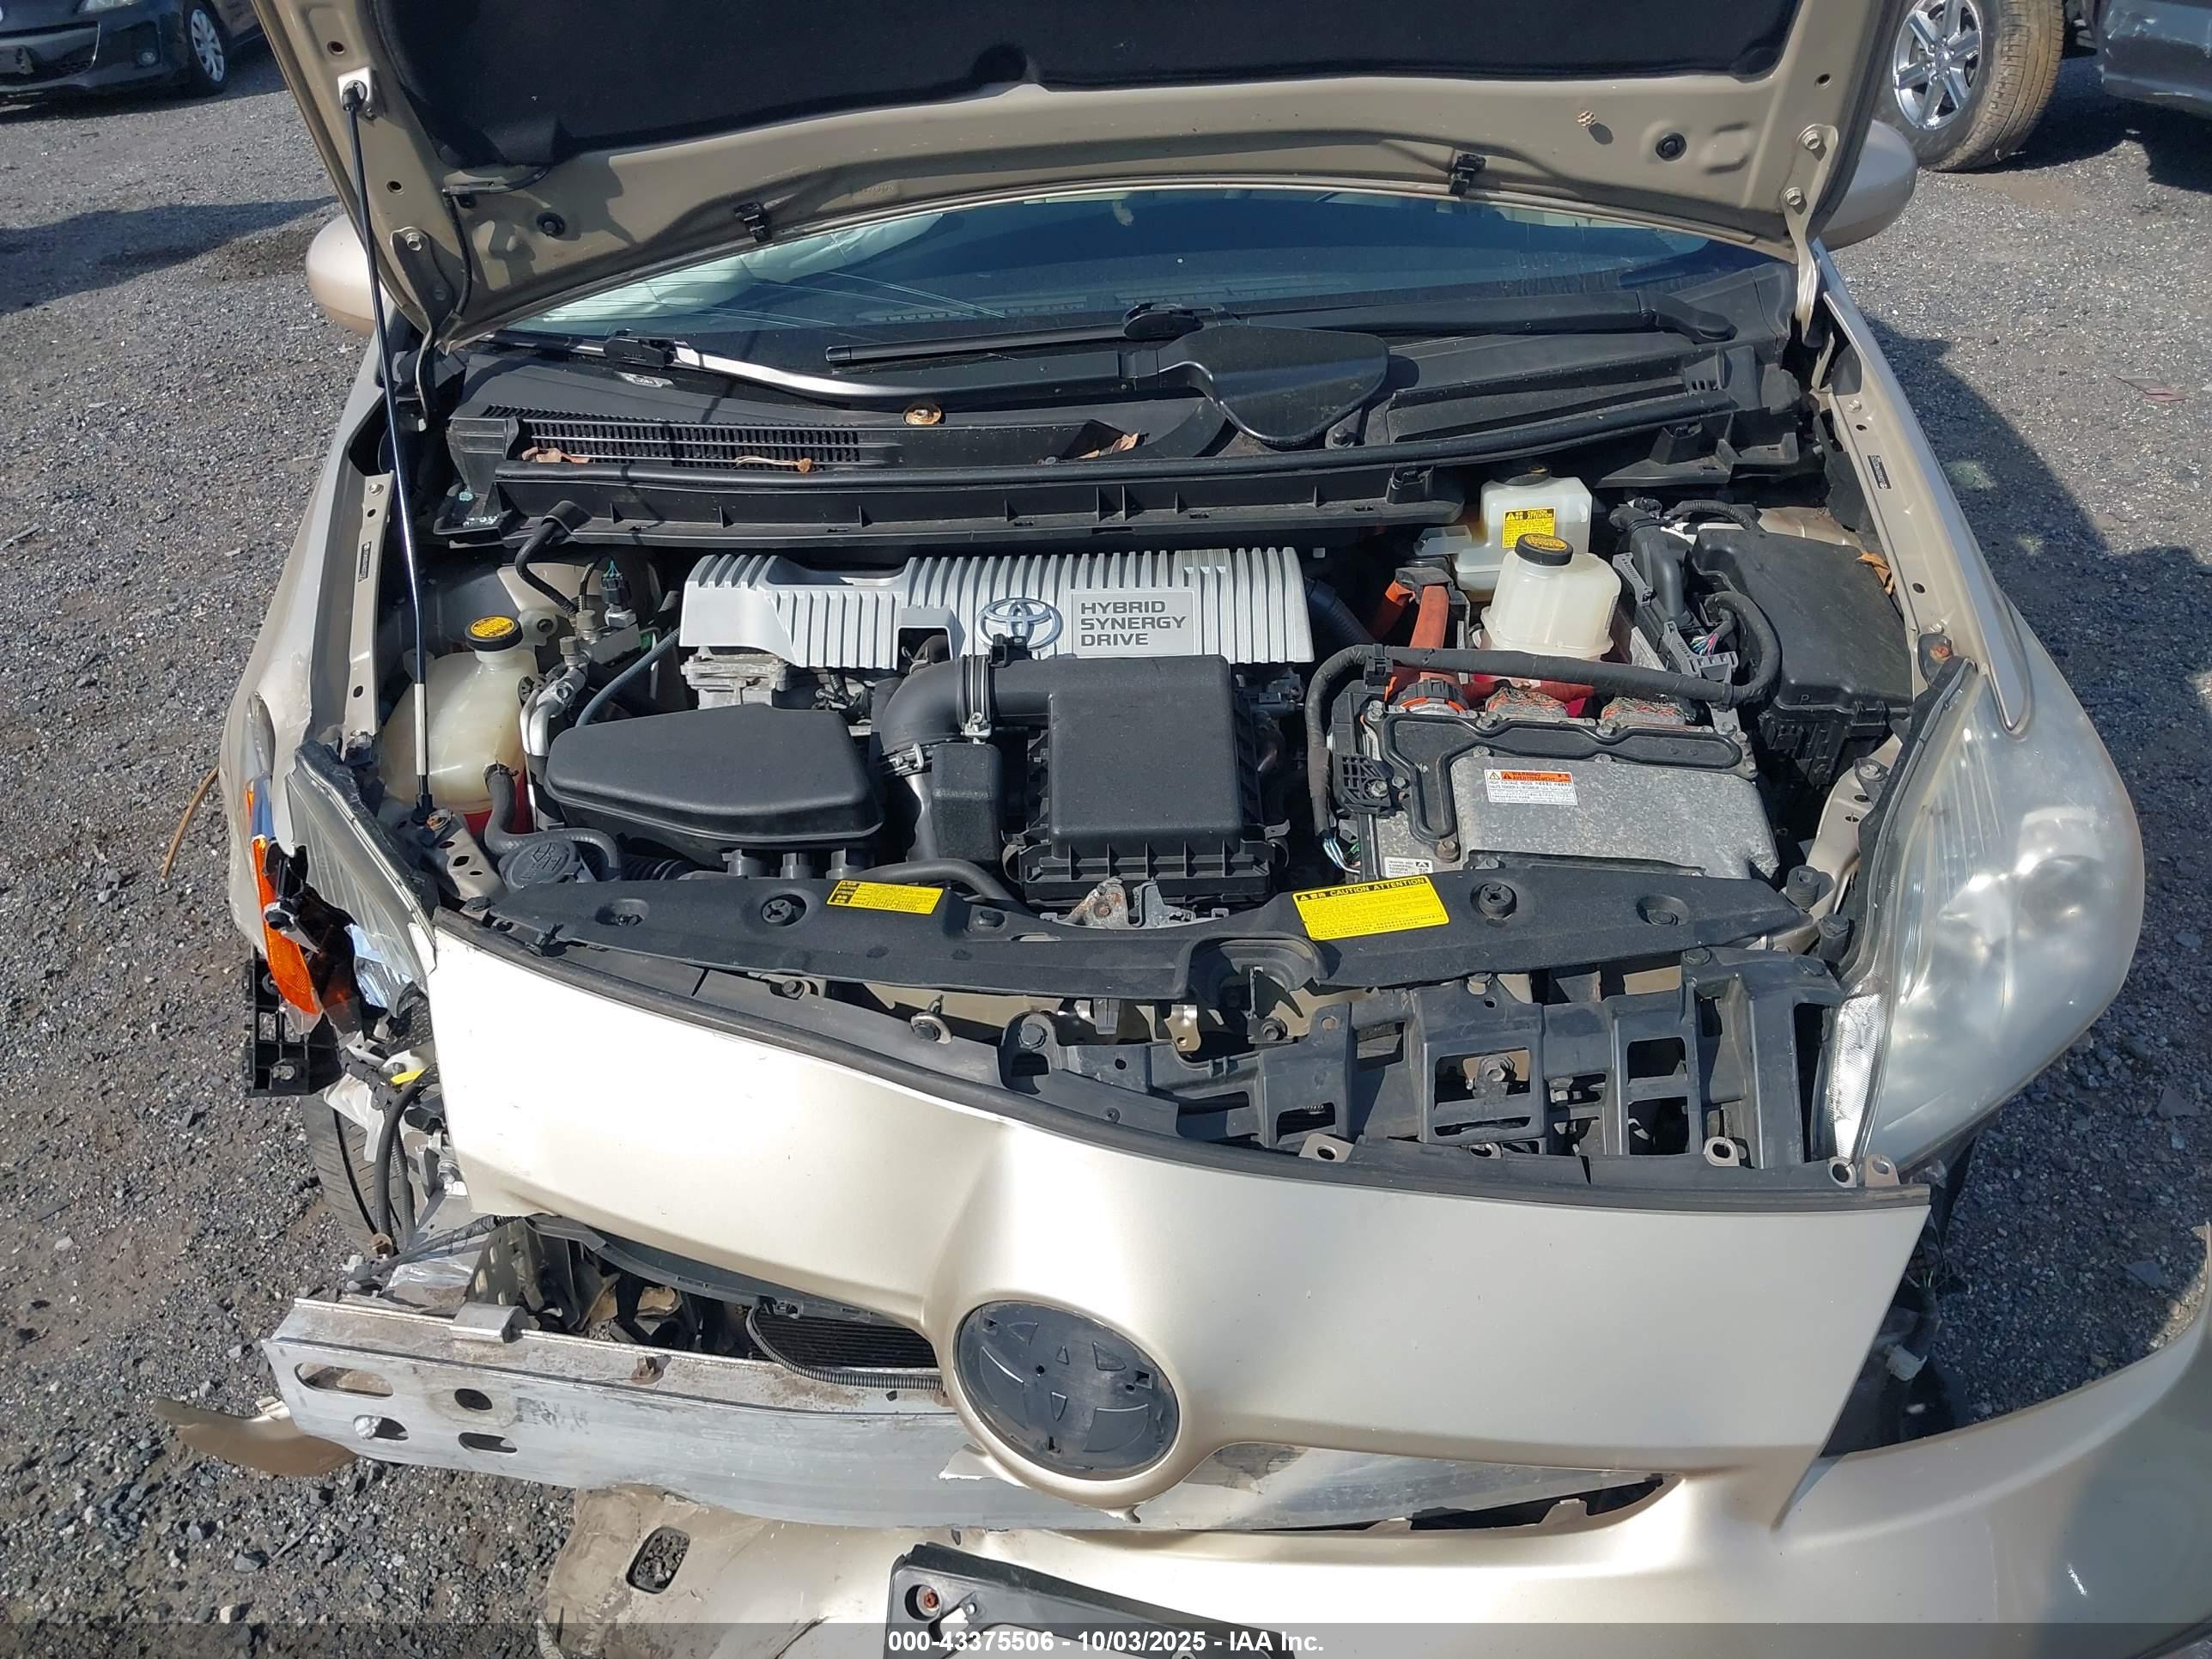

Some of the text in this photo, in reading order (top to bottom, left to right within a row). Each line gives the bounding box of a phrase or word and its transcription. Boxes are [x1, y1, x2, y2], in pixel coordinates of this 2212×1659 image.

[1080, 600, 1166, 615] HYBRID
[1080, 616, 1187, 631] SYNERGY
[1080, 633, 1149, 647] DRIVE
[1329, 885, 1370, 896] CAUTION
[1373, 878, 1425, 890] ATTENTION
